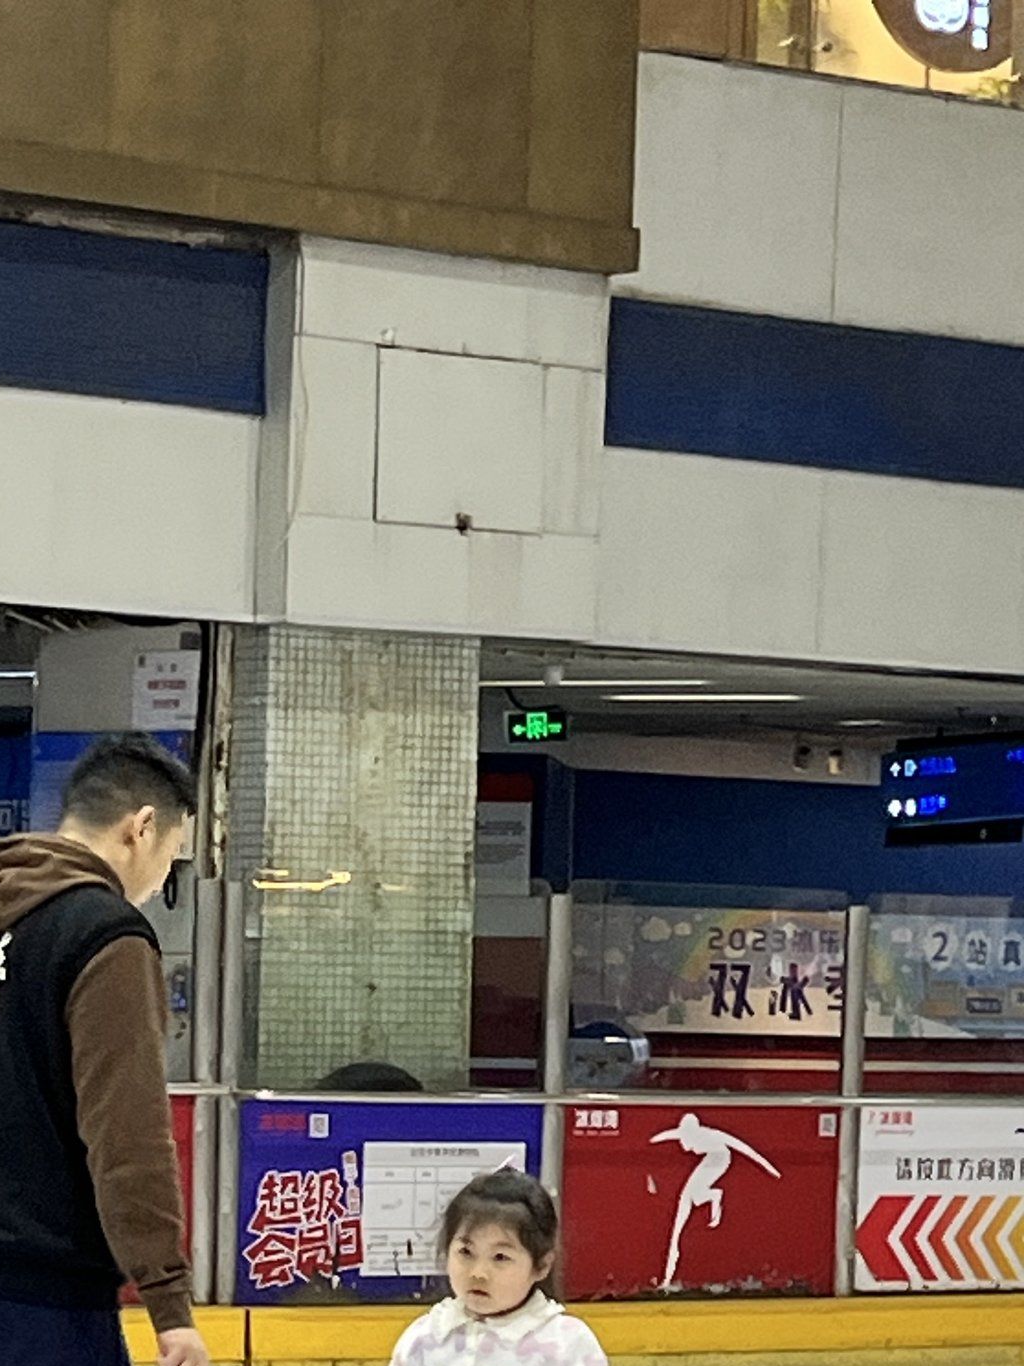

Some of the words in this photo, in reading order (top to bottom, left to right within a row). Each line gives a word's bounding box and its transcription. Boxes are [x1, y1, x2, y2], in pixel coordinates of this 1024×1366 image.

[248, 1170, 346, 1233] 超级
[242, 1216, 364, 1289] 会员日
